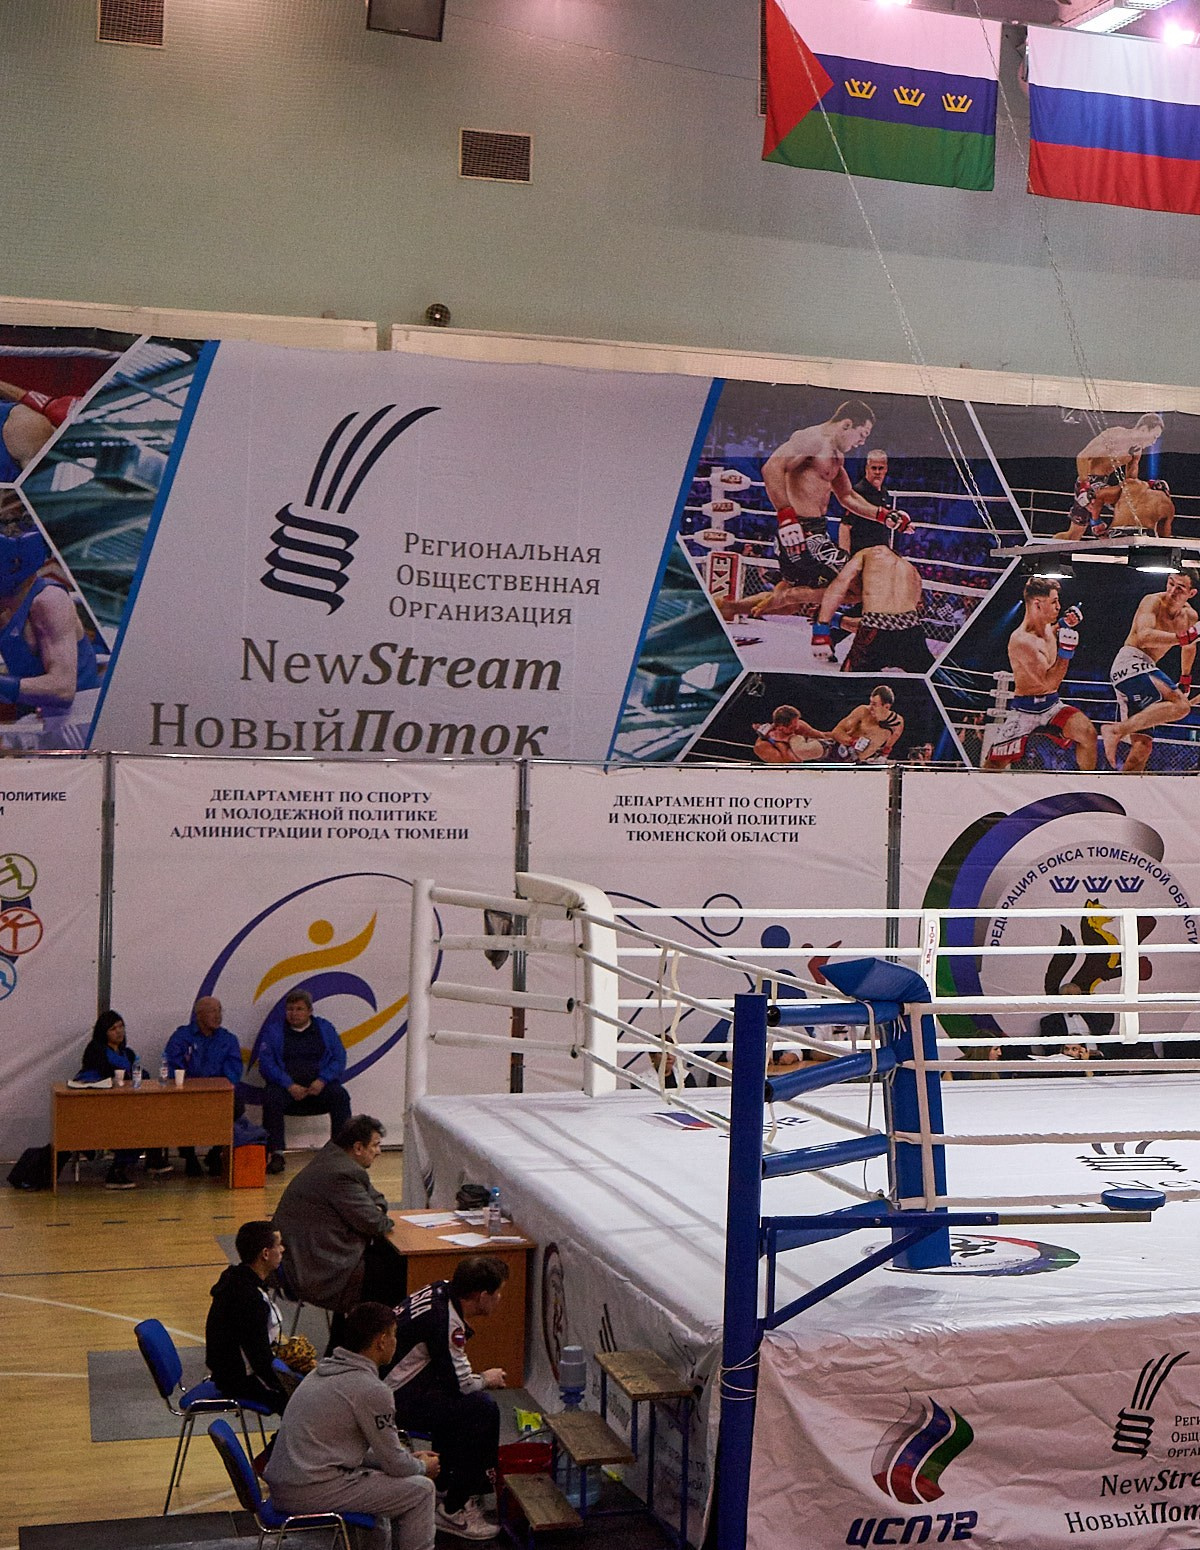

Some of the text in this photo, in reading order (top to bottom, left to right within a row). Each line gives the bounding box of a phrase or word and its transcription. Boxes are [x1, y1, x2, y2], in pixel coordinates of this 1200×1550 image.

[404, 532, 601, 564] РЕГИОНАЛЬНАЯ
[396, 564, 600, 595] ОБЩЕСТВЕННАЯ
[389, 596, 572, 628] ОРГАНИЗАЦИЯ
[240, 637, 562, 691] NewStream
[149, 702, 549, 757] НовыйПоток
[209, 789, 432, 804] ДЕПАРТАМЕНТ ПО СПОРТУ
[613, 795, 812, 809] ДЕПАРТАМЕНТ ПО СПОРТУ
[205, 806, 437, 822] И МОЛОДЕЖНОЙ ПОЛИТИКЕ
[608, 811, 817, 826] И МОЛОДЕЖНОЙ ПОЛИТИКЕ
[170, 826, 469, 840] АДМИНИСТРАЦИИ ГОРОДА ТЮМЕНИ
[626, 829, 799, 843] ТЮМЕНСКОЙ ОБЛАСТИ
[1037, 848, 1084, 875] БОКСА
[1087, 846, 1172, 886] ТЮМЕНСКОЙ
[846, 1510, 978, 1549] ЦСП72
